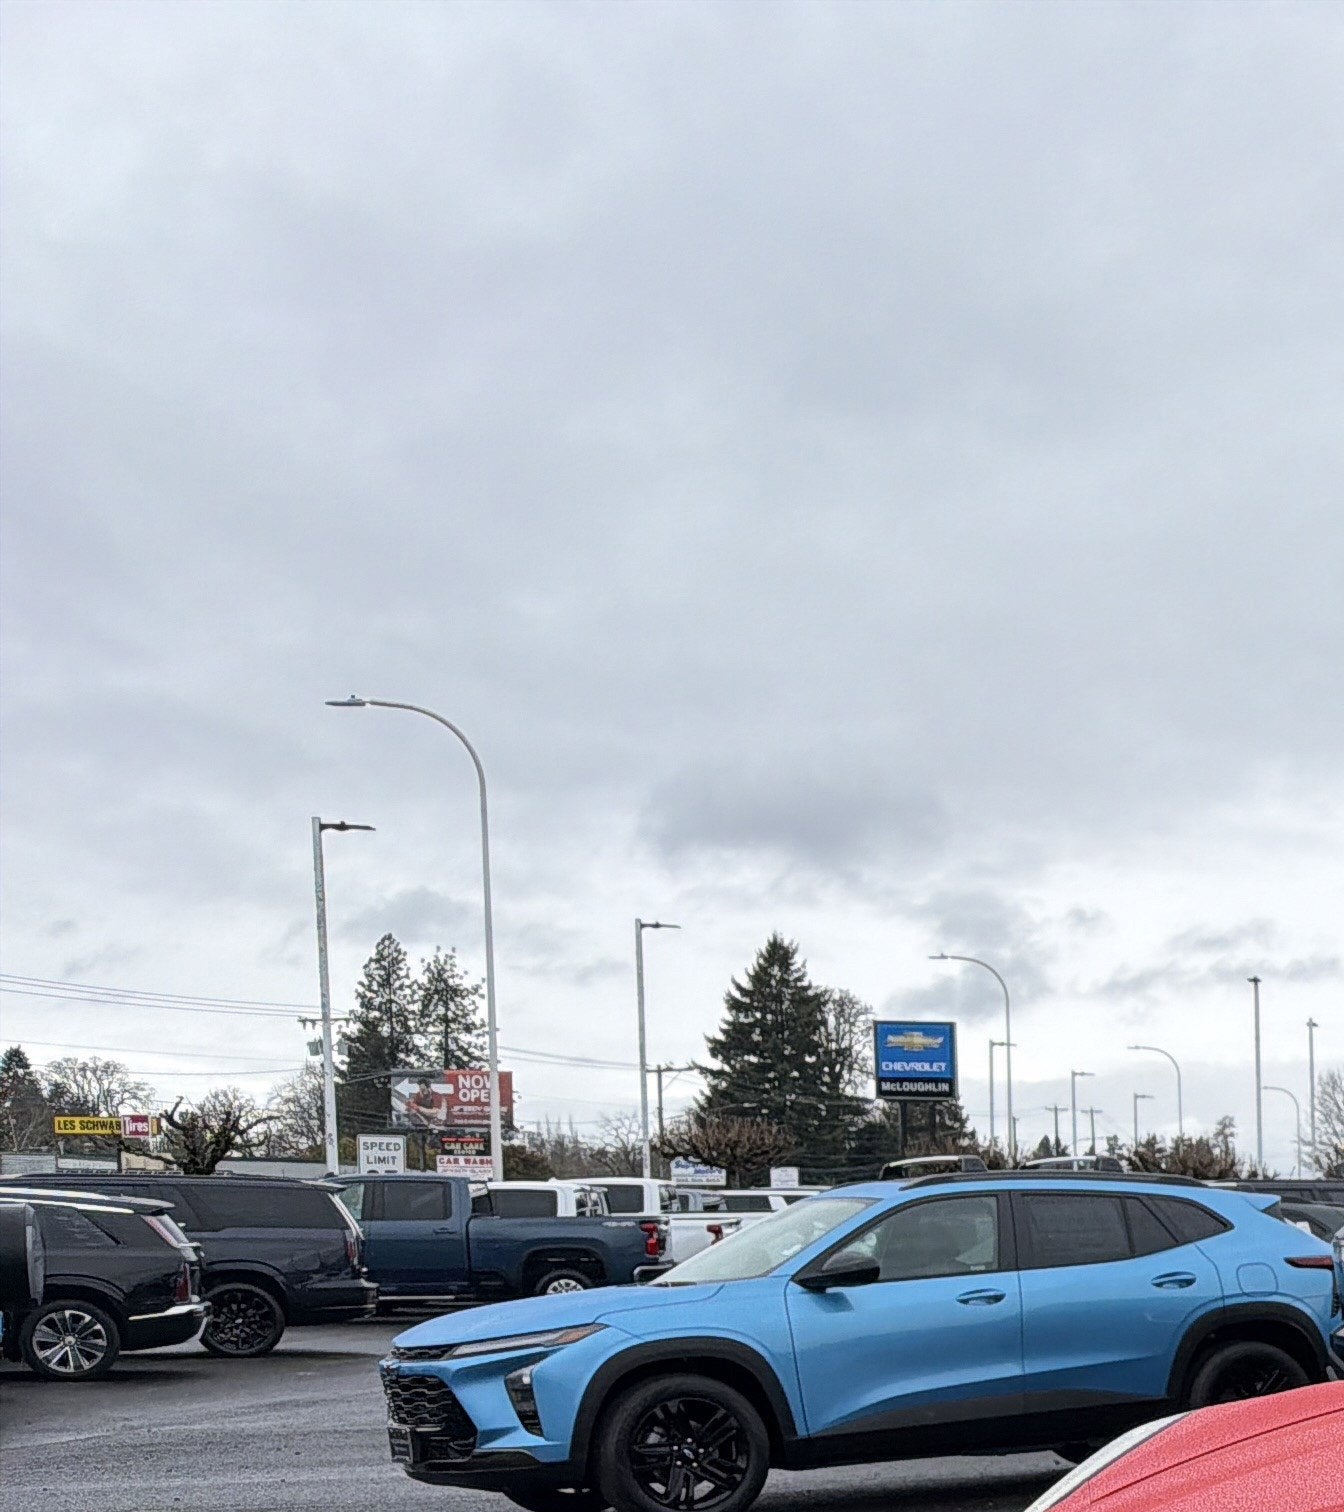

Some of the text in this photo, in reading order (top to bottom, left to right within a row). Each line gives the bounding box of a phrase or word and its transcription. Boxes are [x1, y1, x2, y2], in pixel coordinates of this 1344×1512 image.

[881, 1061, 947, 1073] CHEVROLET
[881, 1081, 950, 1093] McLOUGHLIN
[57, 1119, 76, 1131] LES
[122, 1116, 149, 1134] Tires
[362, 1141, 402, 1151] SPEED
[366, 1155, 397, 1166] LIMIT
[438, 1157, 460, 1165] CAR
